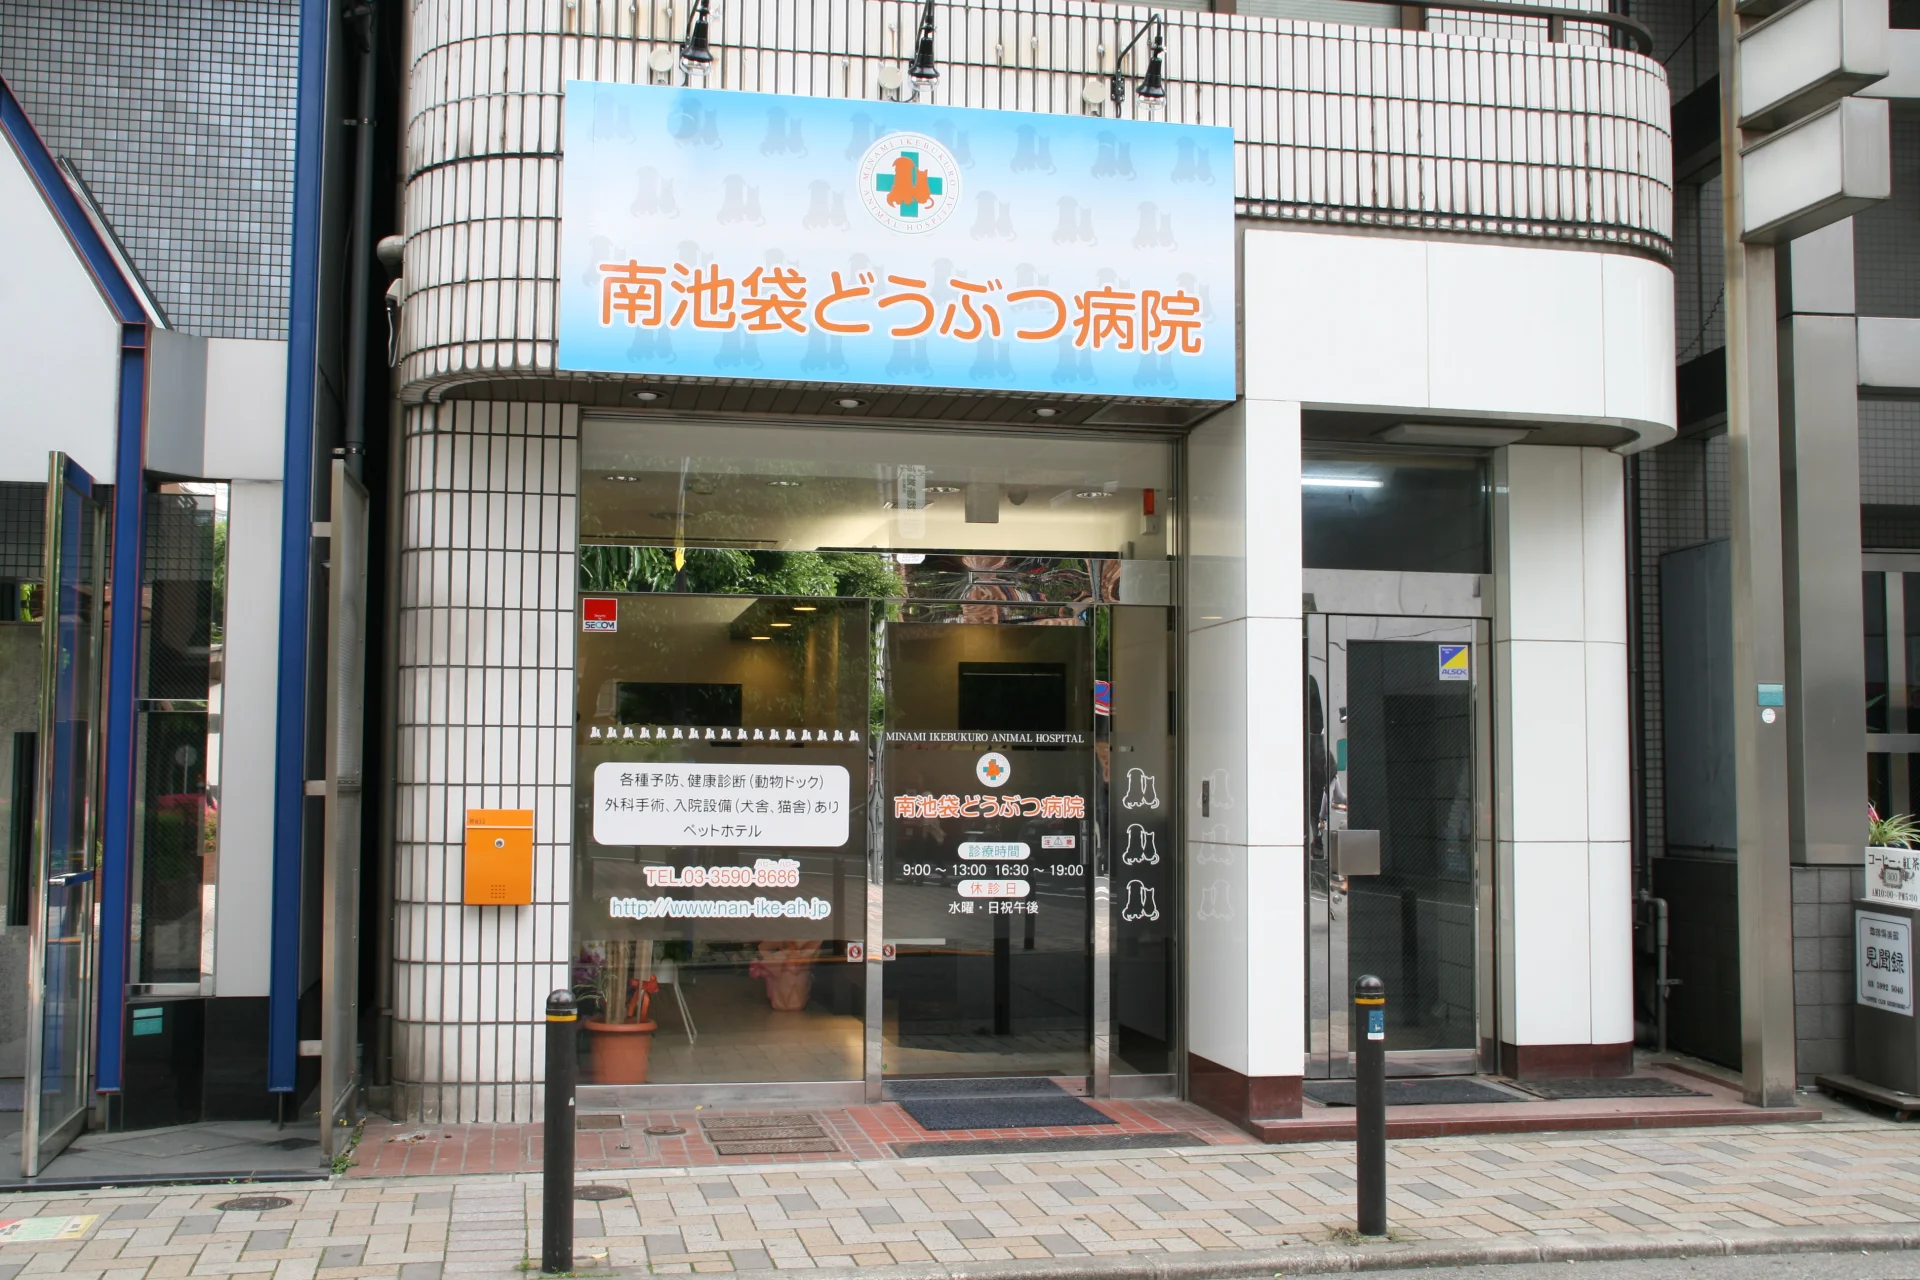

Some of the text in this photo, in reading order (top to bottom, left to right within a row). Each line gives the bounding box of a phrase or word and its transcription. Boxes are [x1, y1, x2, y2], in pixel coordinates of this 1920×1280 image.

[863, 138, 957, 187] MINAMI IKEBUKURO
[863, 190, 955, 231] ANIMAL HOSPITAL
[599, 258, 1203, 355] 南池袋どうぶつ病院
[585, 621, 615, 629] SECOM
[886, 732, 1084, 743] MINAMI IKEBUKURO ANIMAL HOSPITAL
[619, 772, 825, 789] 各種予防、健康診断(動物ドック)
[605, 798, 839, 814] 外科手術、入院設備(犬舎、猫舎)あり
[894, 795, 1084, 818] 南池袋どうぶつ病院
[683, 824, 763, 838] ペットホテル
[968, 844, 1020, 857] 診療時間
[647, 869, 797, 886] TEL.03-3590-8686
[903, 864, 931, 876] 9:00
[953, 864, 986, 876] 13:00
[995, 864, 1029, 876] 16:30
[1050, 864, 1083, 876] 19:00
[970, 882, 1016, 895] 休診日
[612, 900, 829, 918] http://www.nan-ike-ah.jp
[948, 901, 1039, 914] 水曜・日祝午後
[1866, 946, 1905, 974] 見聞録
